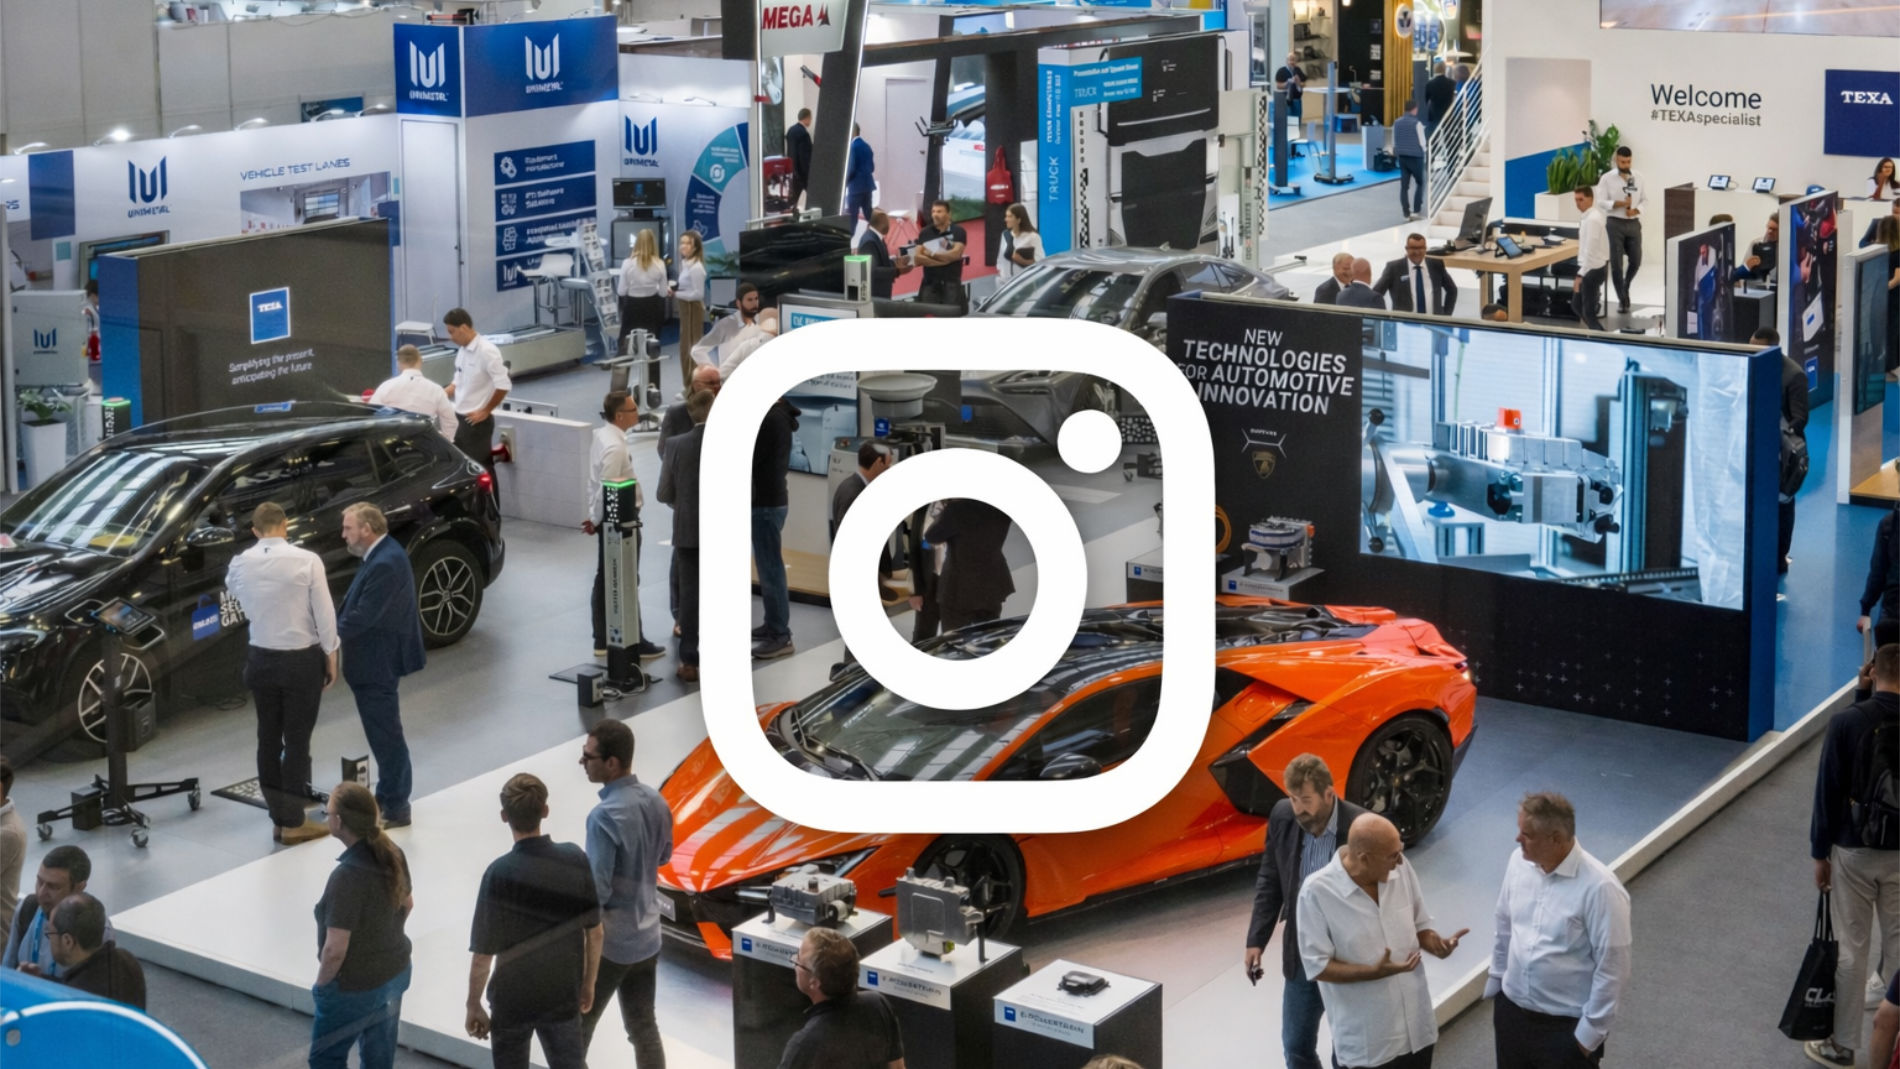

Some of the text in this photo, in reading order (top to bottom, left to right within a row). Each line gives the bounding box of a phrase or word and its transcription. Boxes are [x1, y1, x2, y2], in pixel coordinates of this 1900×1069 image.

[762, 4, 814, 30] MEGA
[1650, 84, 1763, 109] Welcome
[1841, 90, 1894, 105] TEXA
[1650, 109, 1762, 127] #TEXAspecialist
[241, 157, 351, 181] VEHICLE TEST LANES
[1243, 328, 1284, 347] NEW
[1183, 338, 1348, 375] TECHNOLOGIES
[1211, 364, 1356, 396] AUTOMOTIVE
[1197, 382, 1330, 416] INNOVATION
